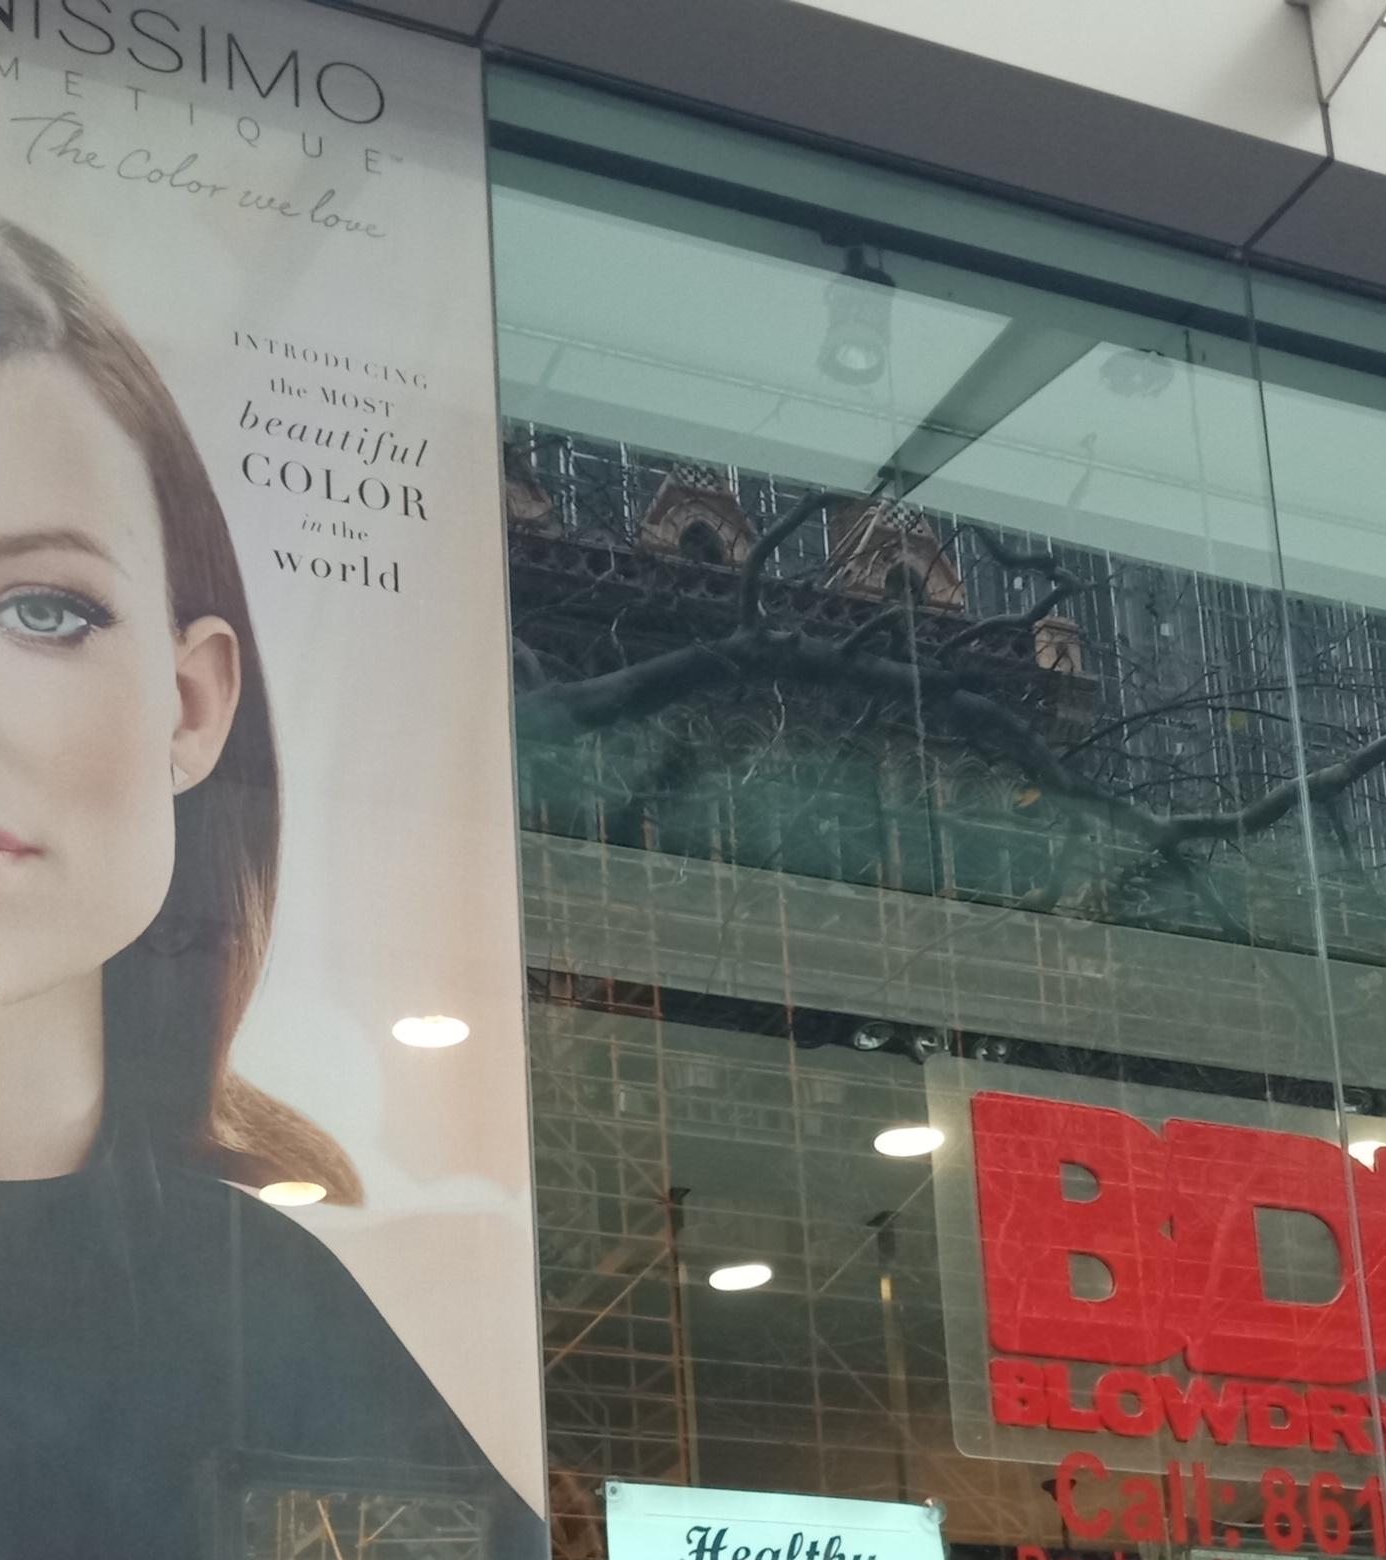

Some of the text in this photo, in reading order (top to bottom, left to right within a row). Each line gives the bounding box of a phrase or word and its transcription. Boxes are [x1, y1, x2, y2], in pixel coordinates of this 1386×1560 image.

[10, 112, 386, 238] The Color we love
[233, 331, 429, 390] INTRODUCING
[270, 377, 395, 418] the MOST
[239, 400, 429, 468] beautiful
[241, 452, 429, 521] COLOR
[301, 514, 369, 542] in the
[273, 549, 401, 594] world
[1056, 1451, 1242, 1547] Call:
